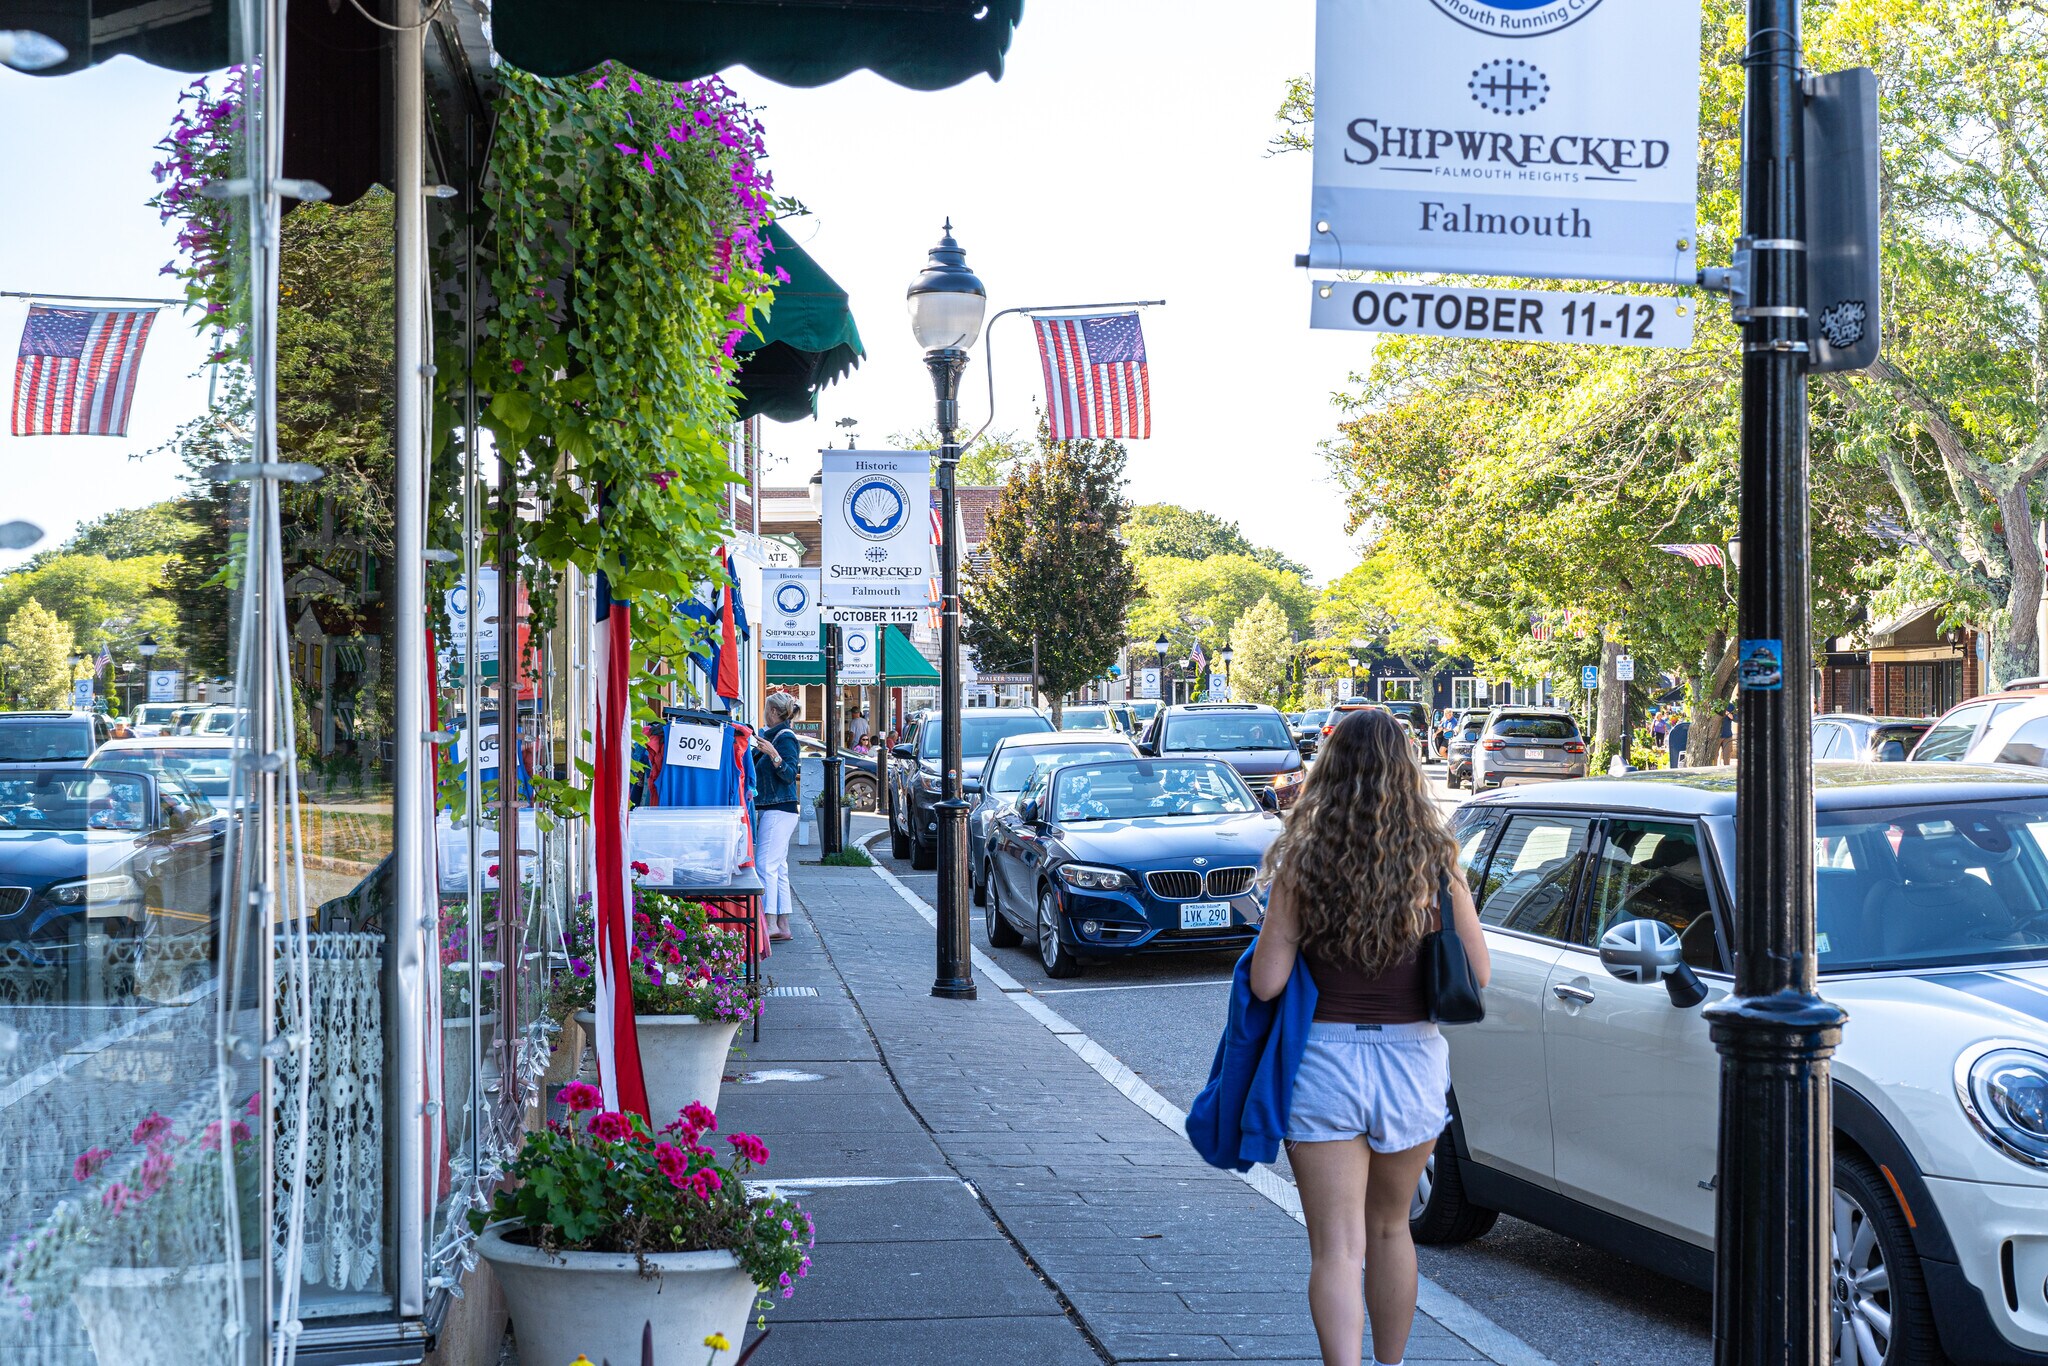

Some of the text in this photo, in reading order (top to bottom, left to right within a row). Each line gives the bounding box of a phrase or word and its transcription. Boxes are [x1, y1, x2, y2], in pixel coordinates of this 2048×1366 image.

[1445, 0, 1569, 29] mouth Running
[1344, 117, 1670, 174] SHIPWRECKED
[1434, 166, 1580, 183] FALMOUTH HEIGHTS
[1418, 201, 1592, 239] Falmouth
[1352, 289, 1656, 339] OCTOBER 11-12
[855, 461, 898, 470] Historic
[862, 476, 893, 485] MARATHON
[891, 482, 908, 505] WEEKEND
[830, 564, 922, 578] SHIPWRECKED
[852, 586, 901, 596] Falmouth
[833, 611, 918, 622] OCTOBER 11-12
[766, 629, 816, 637] SHIPWRECKED
[679, 736, 711, 752] 50%
[1184, 909, 1227, 922] 1VK 290
